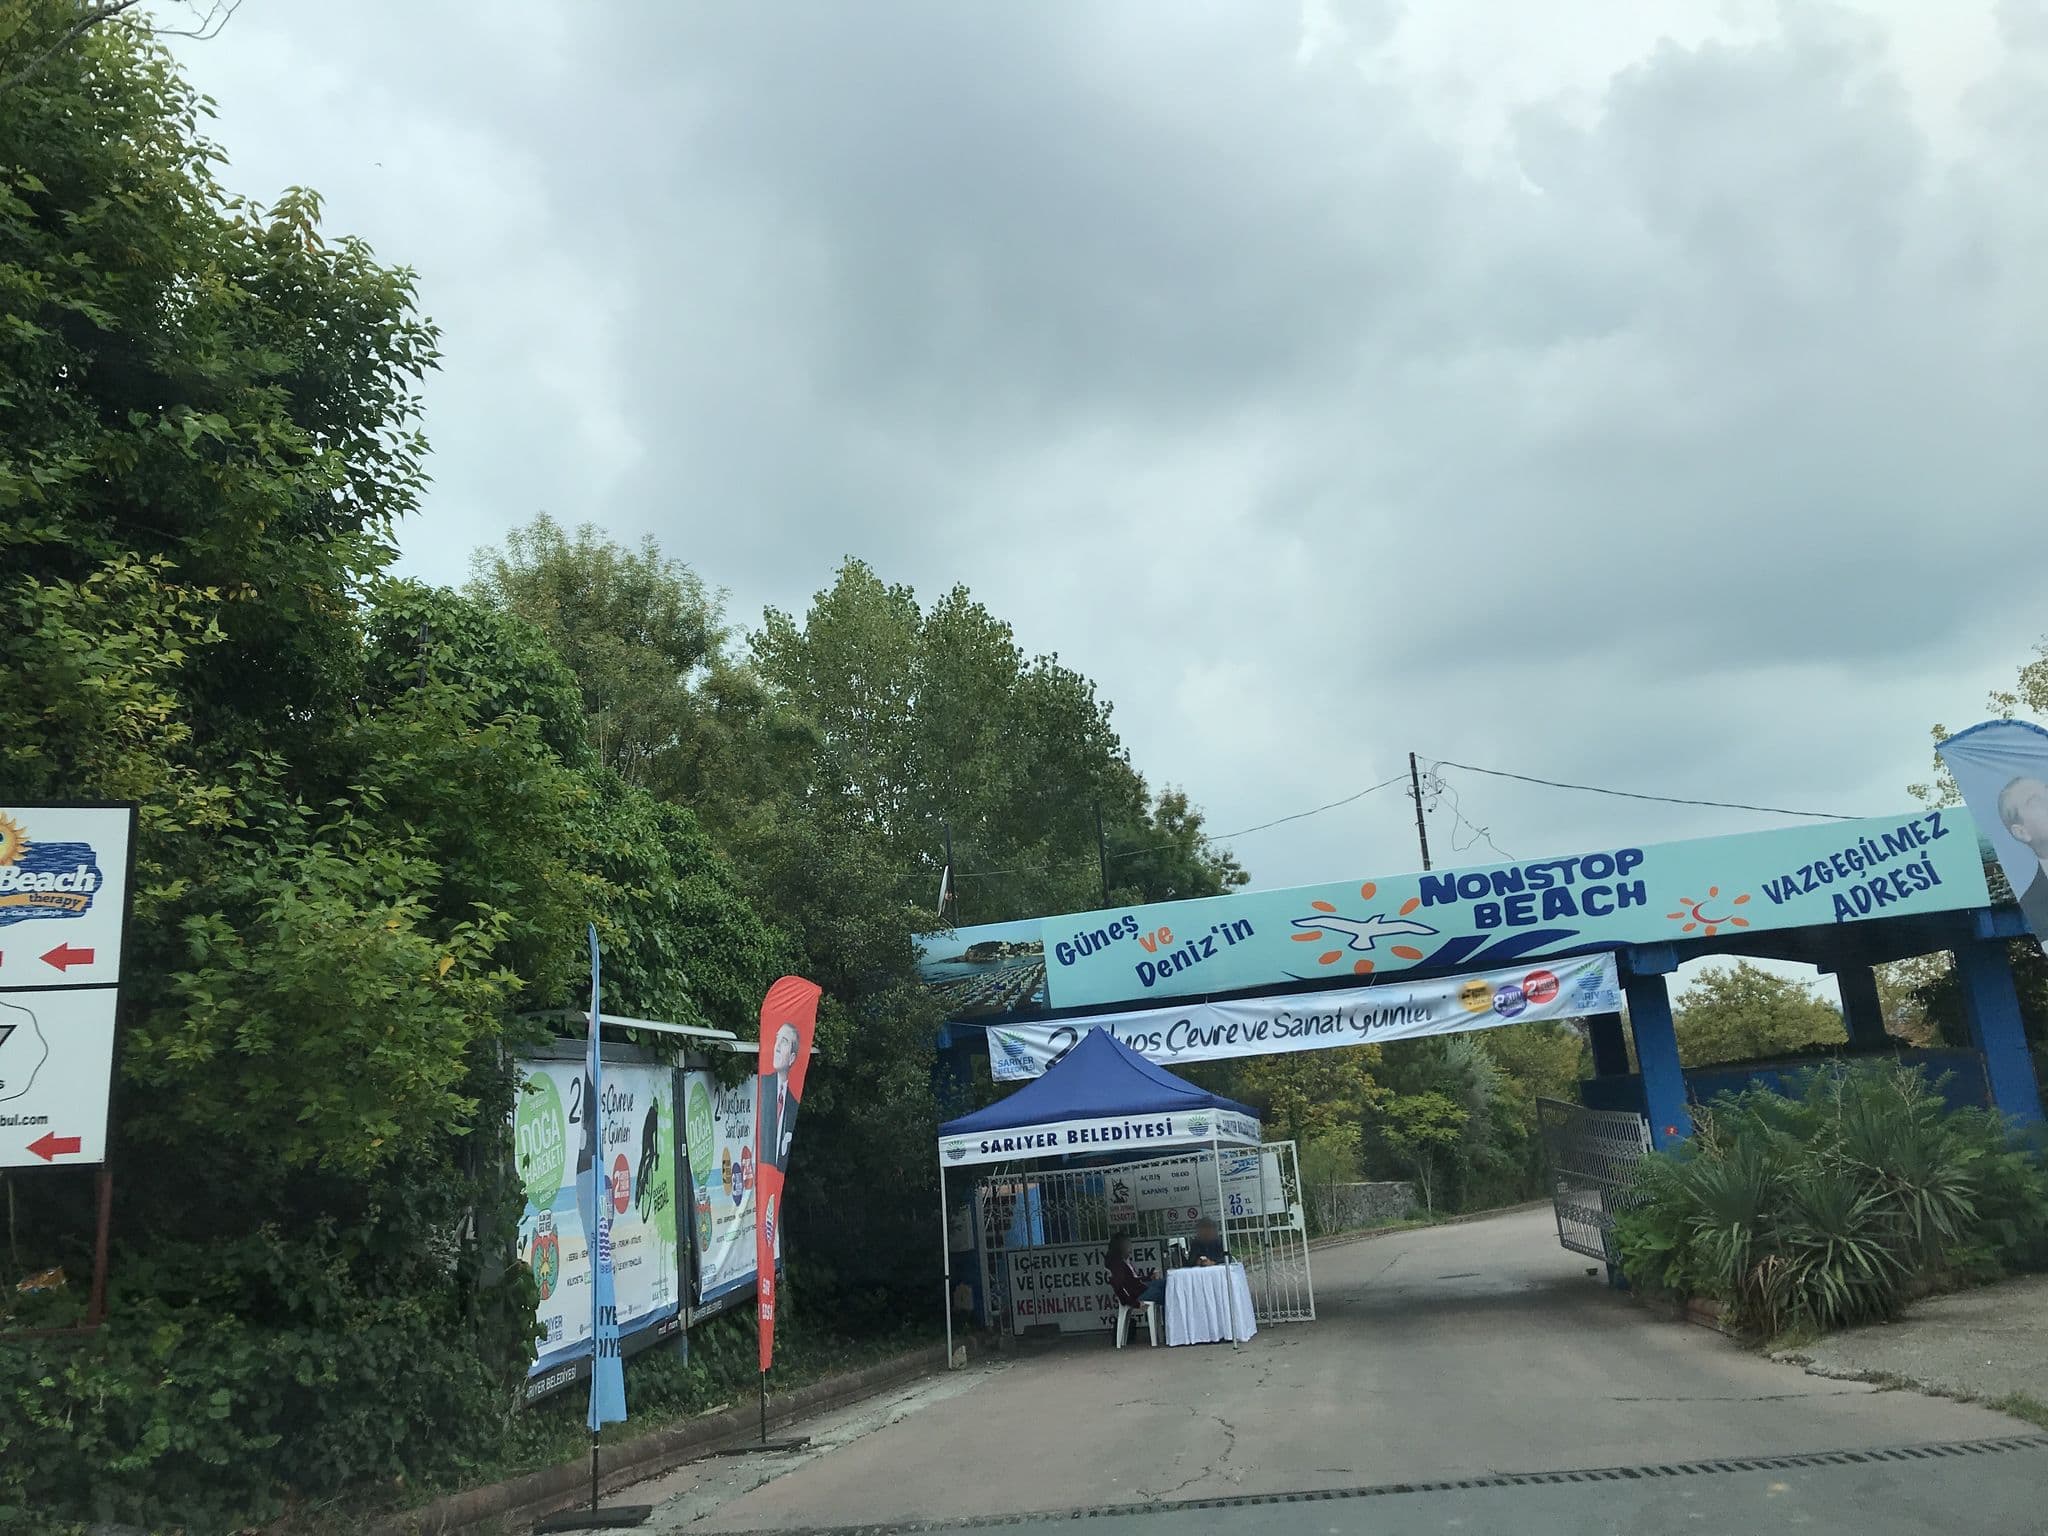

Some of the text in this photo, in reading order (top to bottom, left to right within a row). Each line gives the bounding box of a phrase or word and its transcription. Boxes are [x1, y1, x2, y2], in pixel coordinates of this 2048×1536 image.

[29, 892, 82, 909] therapy
[1418, 848, 1644, 907] NONSTOP
[1832, 850, 1943, 924] ADRESİ
[1473, 879, 1647, 930] BEACH
[1055, 914, 1174, 967] Güneş ve
[1135, 917, 1255, 988] Deniz'in
[1166, 1019, 1238, 1056] Çevre
[1272, 1006, 1344, 1039] Sanat
[980, 1116, 1174, 1154] SARIYER BELEDİYESİ
[1228, 1193, 1242, 1205] 25
[1230, 1203, 1244, 1215] 40
[1039, 1271, 1091, 1293] İÇECEK
